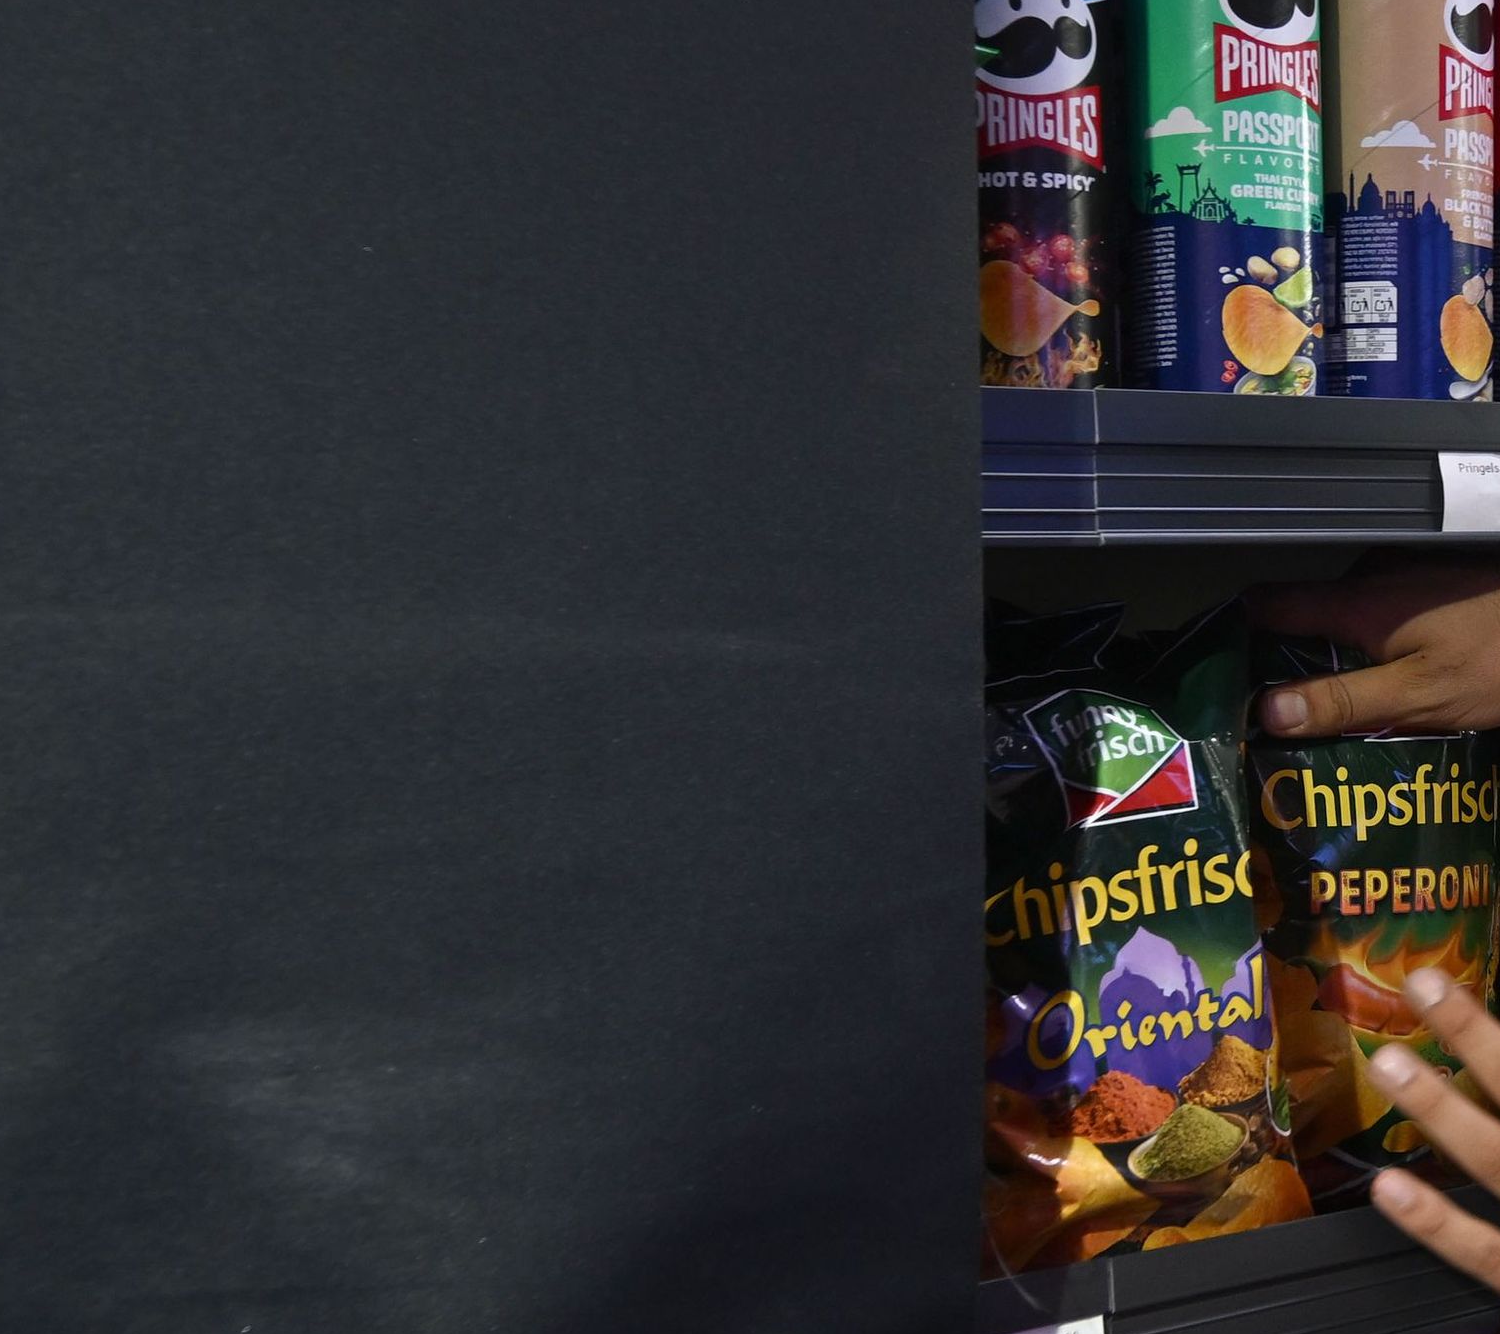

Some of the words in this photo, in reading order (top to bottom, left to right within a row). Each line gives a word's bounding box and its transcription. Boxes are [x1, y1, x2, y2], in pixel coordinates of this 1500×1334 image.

[1222, 34, 1319, 107] PRINGLES
[974, 94, 1097, 158] PRINGLES
[979, 172, 1019, 188] HOT
[1023, 172, 1038, 188] &
[1045, 173, 1095, 192] SPICY
[1254, 173, 1278, 185] THAI
[1230, 185, 1283, 200] GREEN
[1444, 199, 1478, 213] BLACK
[1458, 463, 1499, 476] Pringels
[1310, 862, 1490, 917] PEPERONI
[1027, 951, 1265, 1070] Oriental
